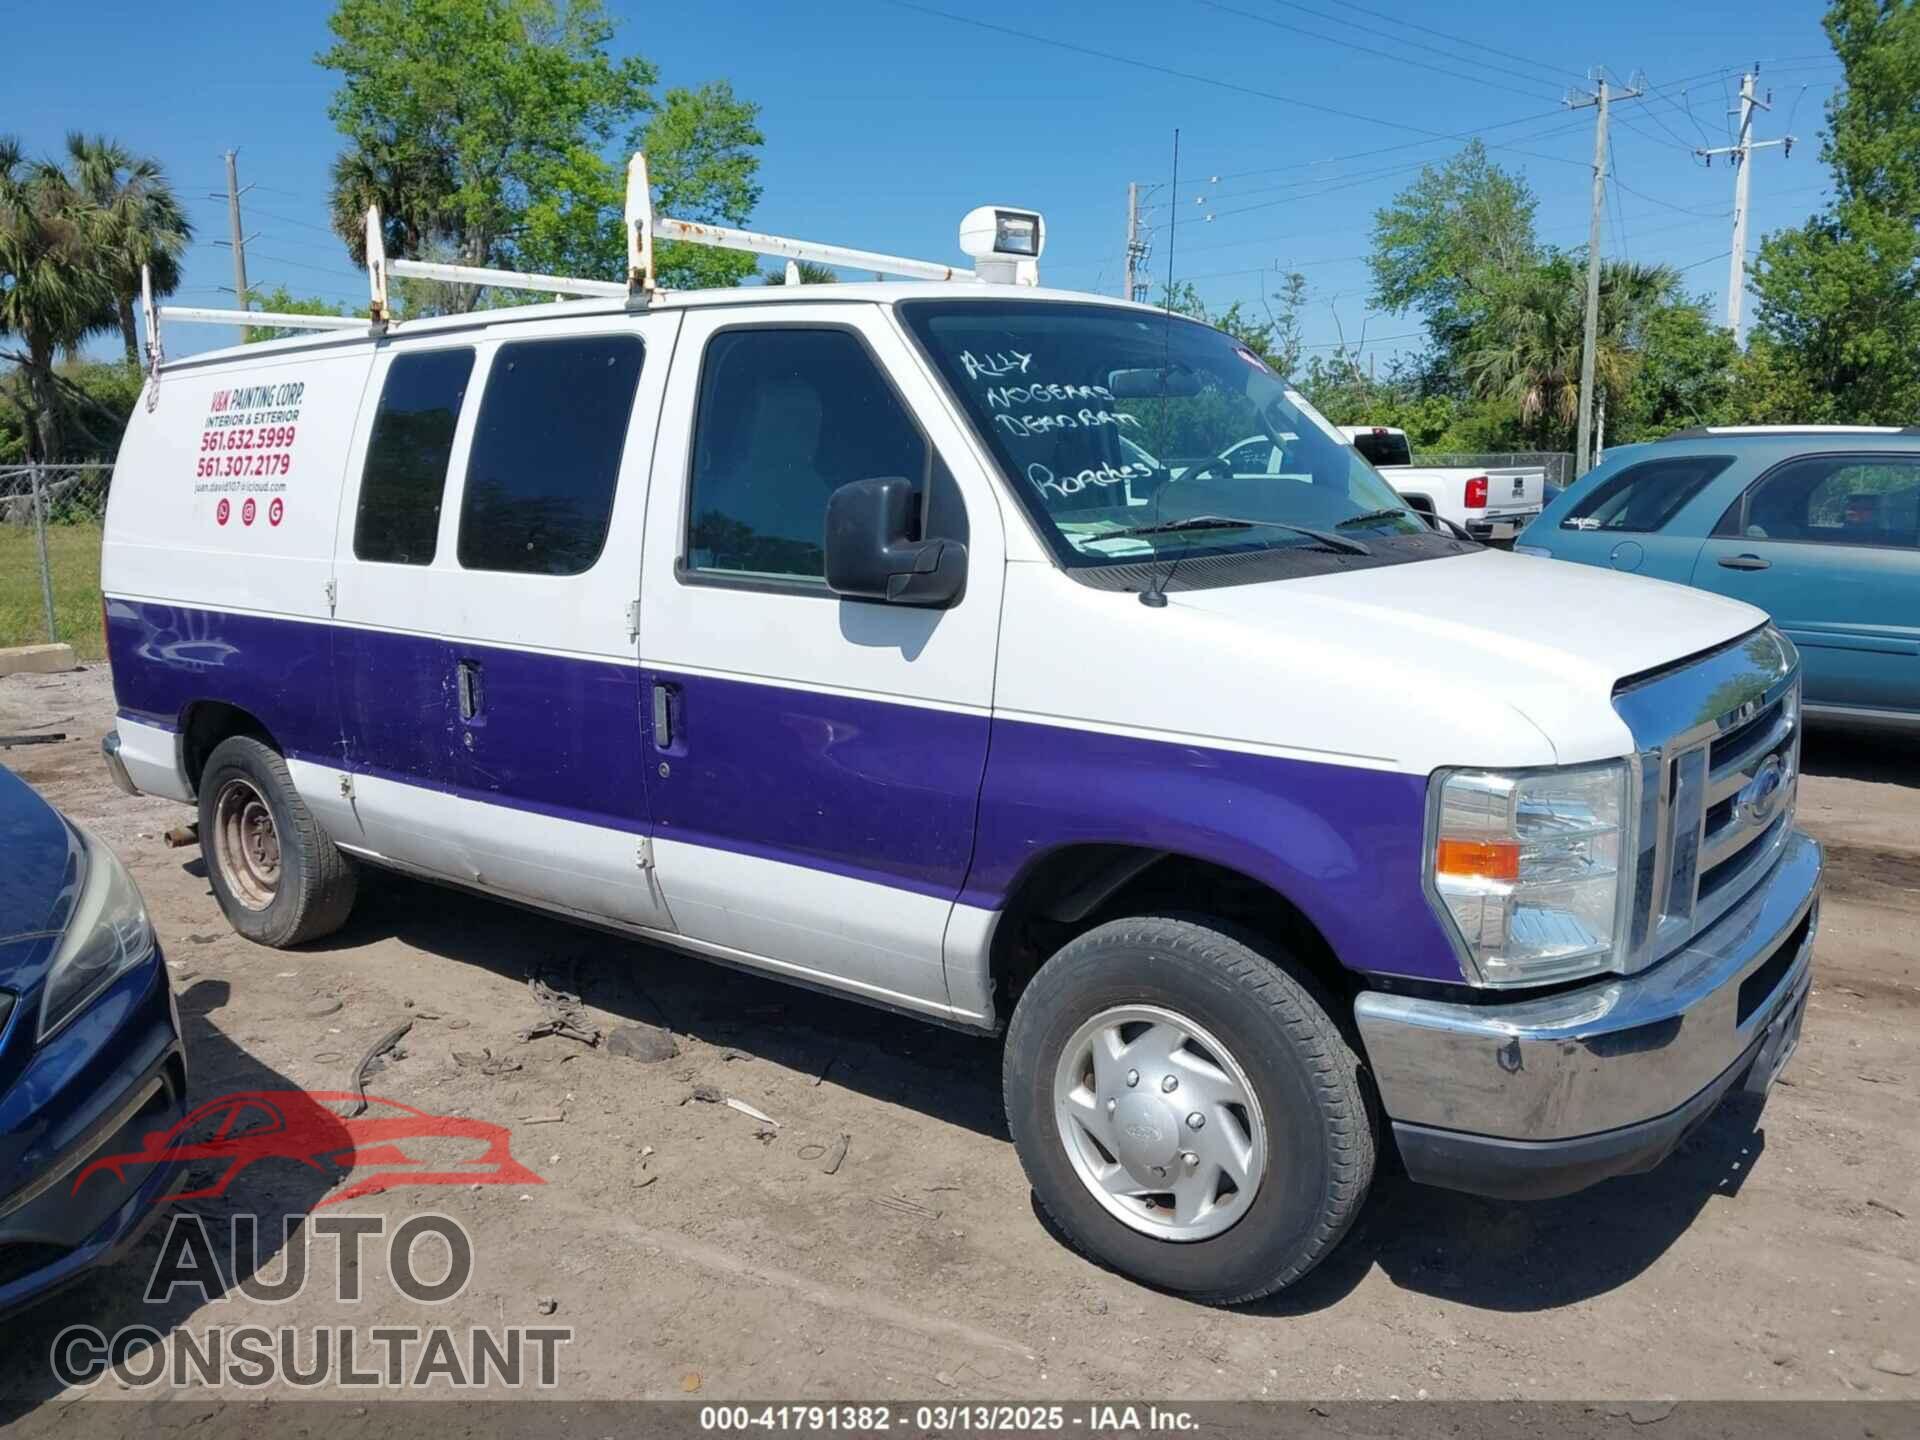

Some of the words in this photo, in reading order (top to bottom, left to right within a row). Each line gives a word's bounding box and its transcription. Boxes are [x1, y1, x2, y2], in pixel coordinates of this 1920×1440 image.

[961, 350, 1032, 380] ALLY
[230, 383, 277, 410] PAINTING
[276, 381, 304, 406] CORP.
[206, 413, 244, 428] INTERIOR
[246, 412, 253, 425] &
[254, 409, 299, 424] EXTERIOR
[201, 426, 295, 451] 561.632.5999
[197, 453, 290, 477] 561.307.2179
